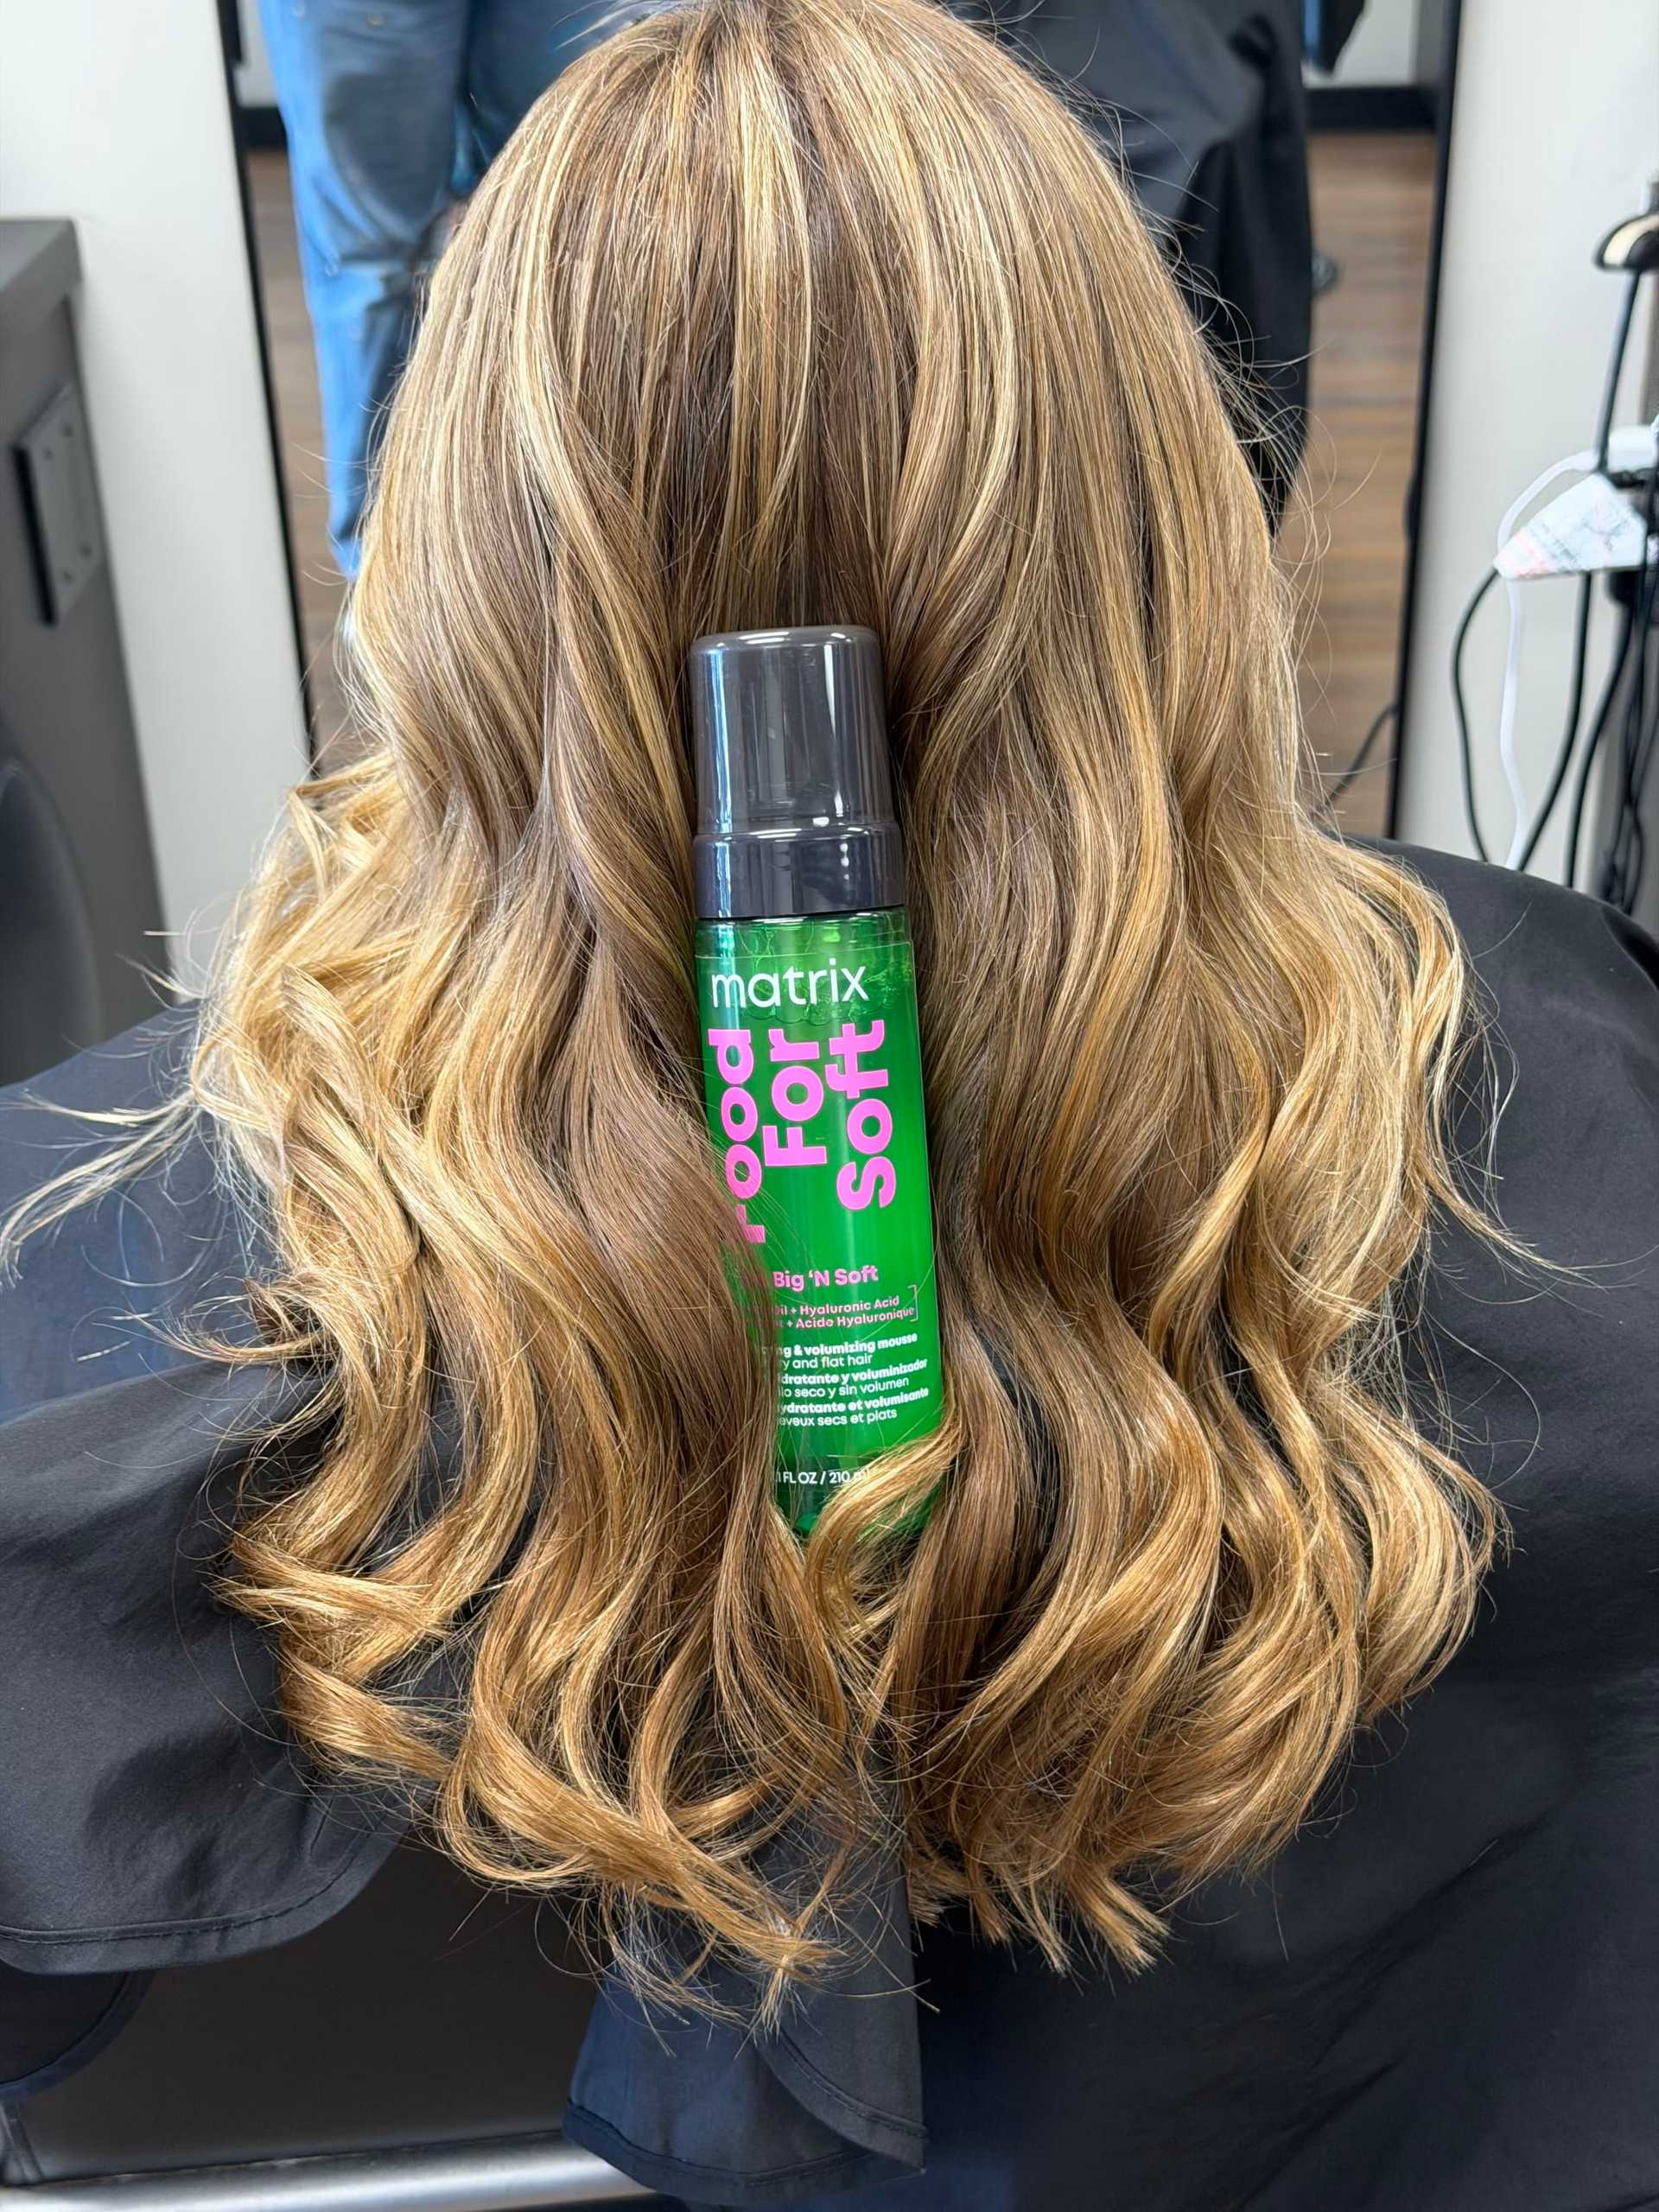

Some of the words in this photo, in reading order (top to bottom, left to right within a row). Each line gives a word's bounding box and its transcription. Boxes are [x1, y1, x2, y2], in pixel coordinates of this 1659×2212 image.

[711, 957, 869, 1008] matrix
[762, 1028, 828, 1166] For
[825, 1019, 896, 1211] Soft
[773, 1270, 804, 1292] Big
[835, 1265, 878, 1286] Soft
[796, 1319, 834, 1329] Acide
[837, 1306, 915, 1328] Hyaluronique
[800, 1300, 871, 1318] Hyaluronic
[874, 1295, 899, 1308] Acid
[793, 1345, 803, 1356] &
[804, 1339, 876, 1356] volumizing
[878, 1333, 918, 1350] mousse
[792, 1357, 818, 1369] and
[821, 1355, 845, 1368] flat
[848, 1353, 874, 1365] hair
[852, 1358, 927, 1381] voluminizador
[795, 1387, 825, 1397] seco
[839, 1384, 858, 1395] sin
[860, 1376, 910, 1392] volumen
[848, 1401, 862, 1410] et
[864, 1387, 929, 1408] volumisante
[817, 1412, 848, 1425] secs
[850, 1410, 864, 1423] et
[867, 1408, 898, 1423] plats
[783, 1471, 797, 1484] FL
[798, 1471, 817, 1484] OZ
[829, 1471, 850, 1484] 210
